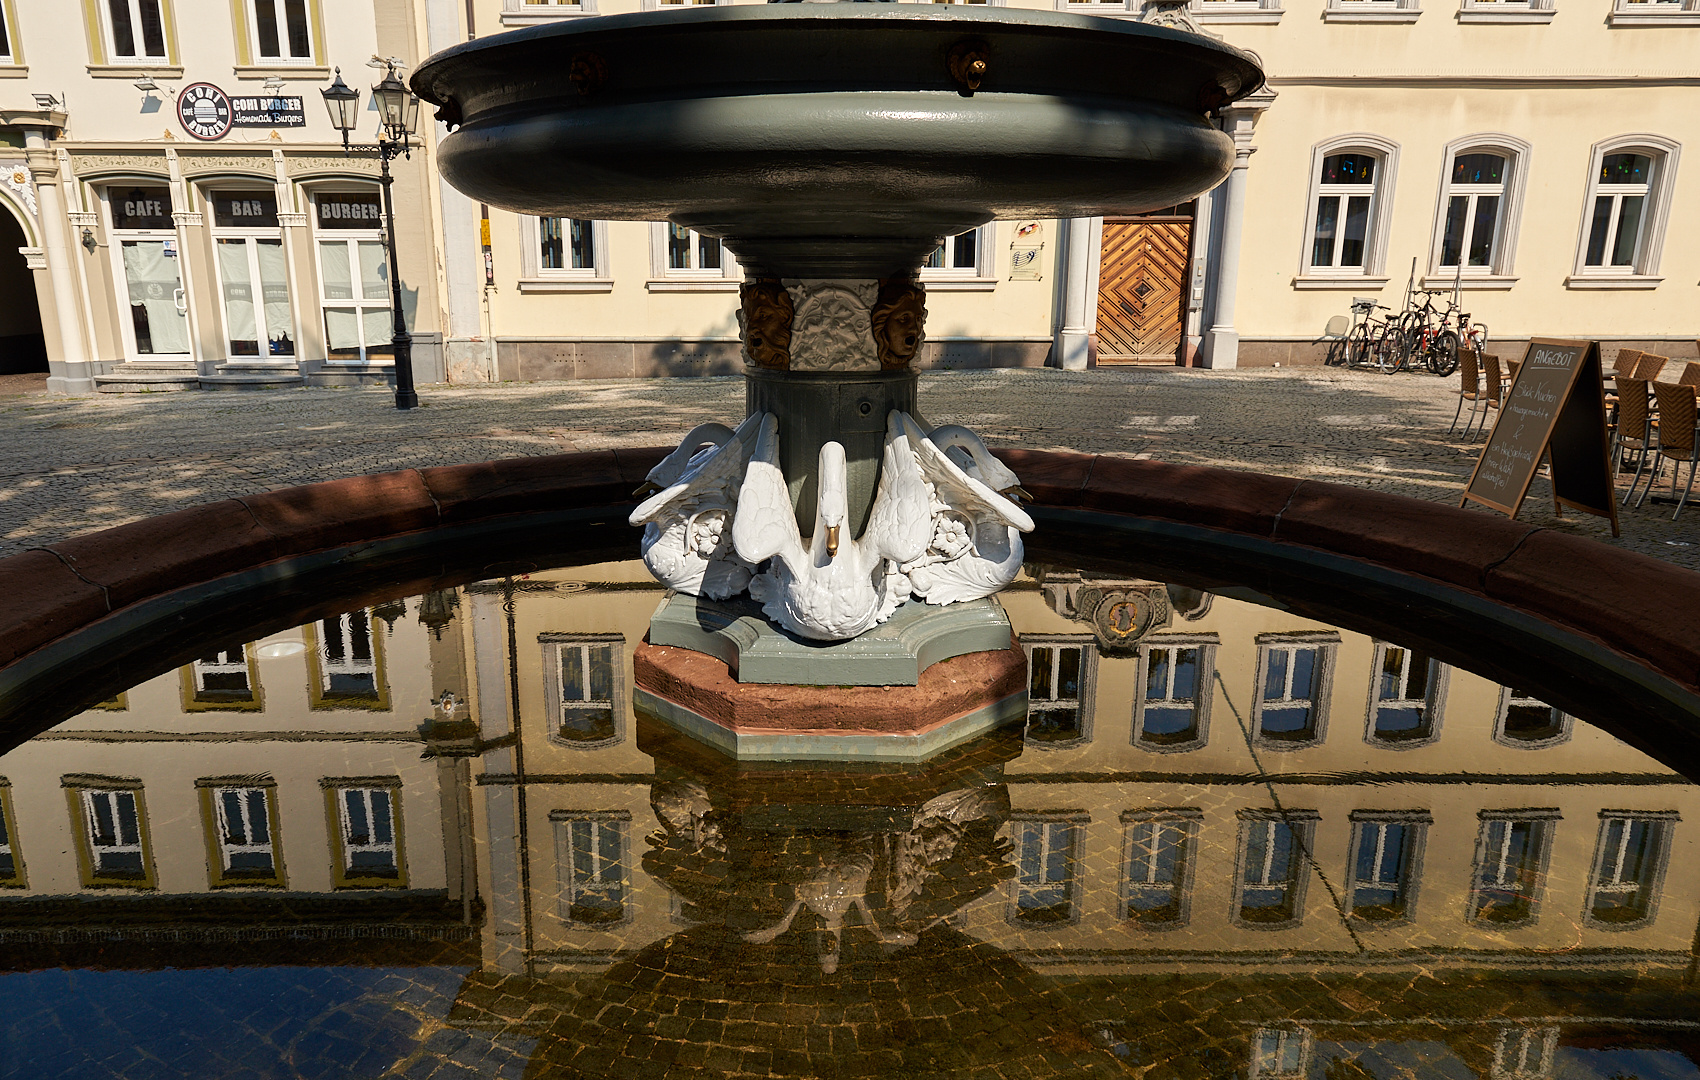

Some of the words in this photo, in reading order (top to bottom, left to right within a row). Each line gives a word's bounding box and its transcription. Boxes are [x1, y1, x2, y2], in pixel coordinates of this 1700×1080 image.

[186, 87, 220, 103] COHI
[218, 107, 227, 116] BAR
[232, 98, 258, 111] COHI
[260, 98, 302, 111] BURGER
[188, 119, 226, 136] BURGER
[234, 111, 273, 124] Homemade
[273, 112, 303, 127] Burgers
[124, 200, 163, 217] CAFE
[231, 200, 263, 217] BAR
[321, 202, 379, 219] BURGER
[1533, 349, 1576, 367] ANGEBOT
[1534, 381, 1557, 404] Kuchen
[1512, 424, 1525, 440] &
